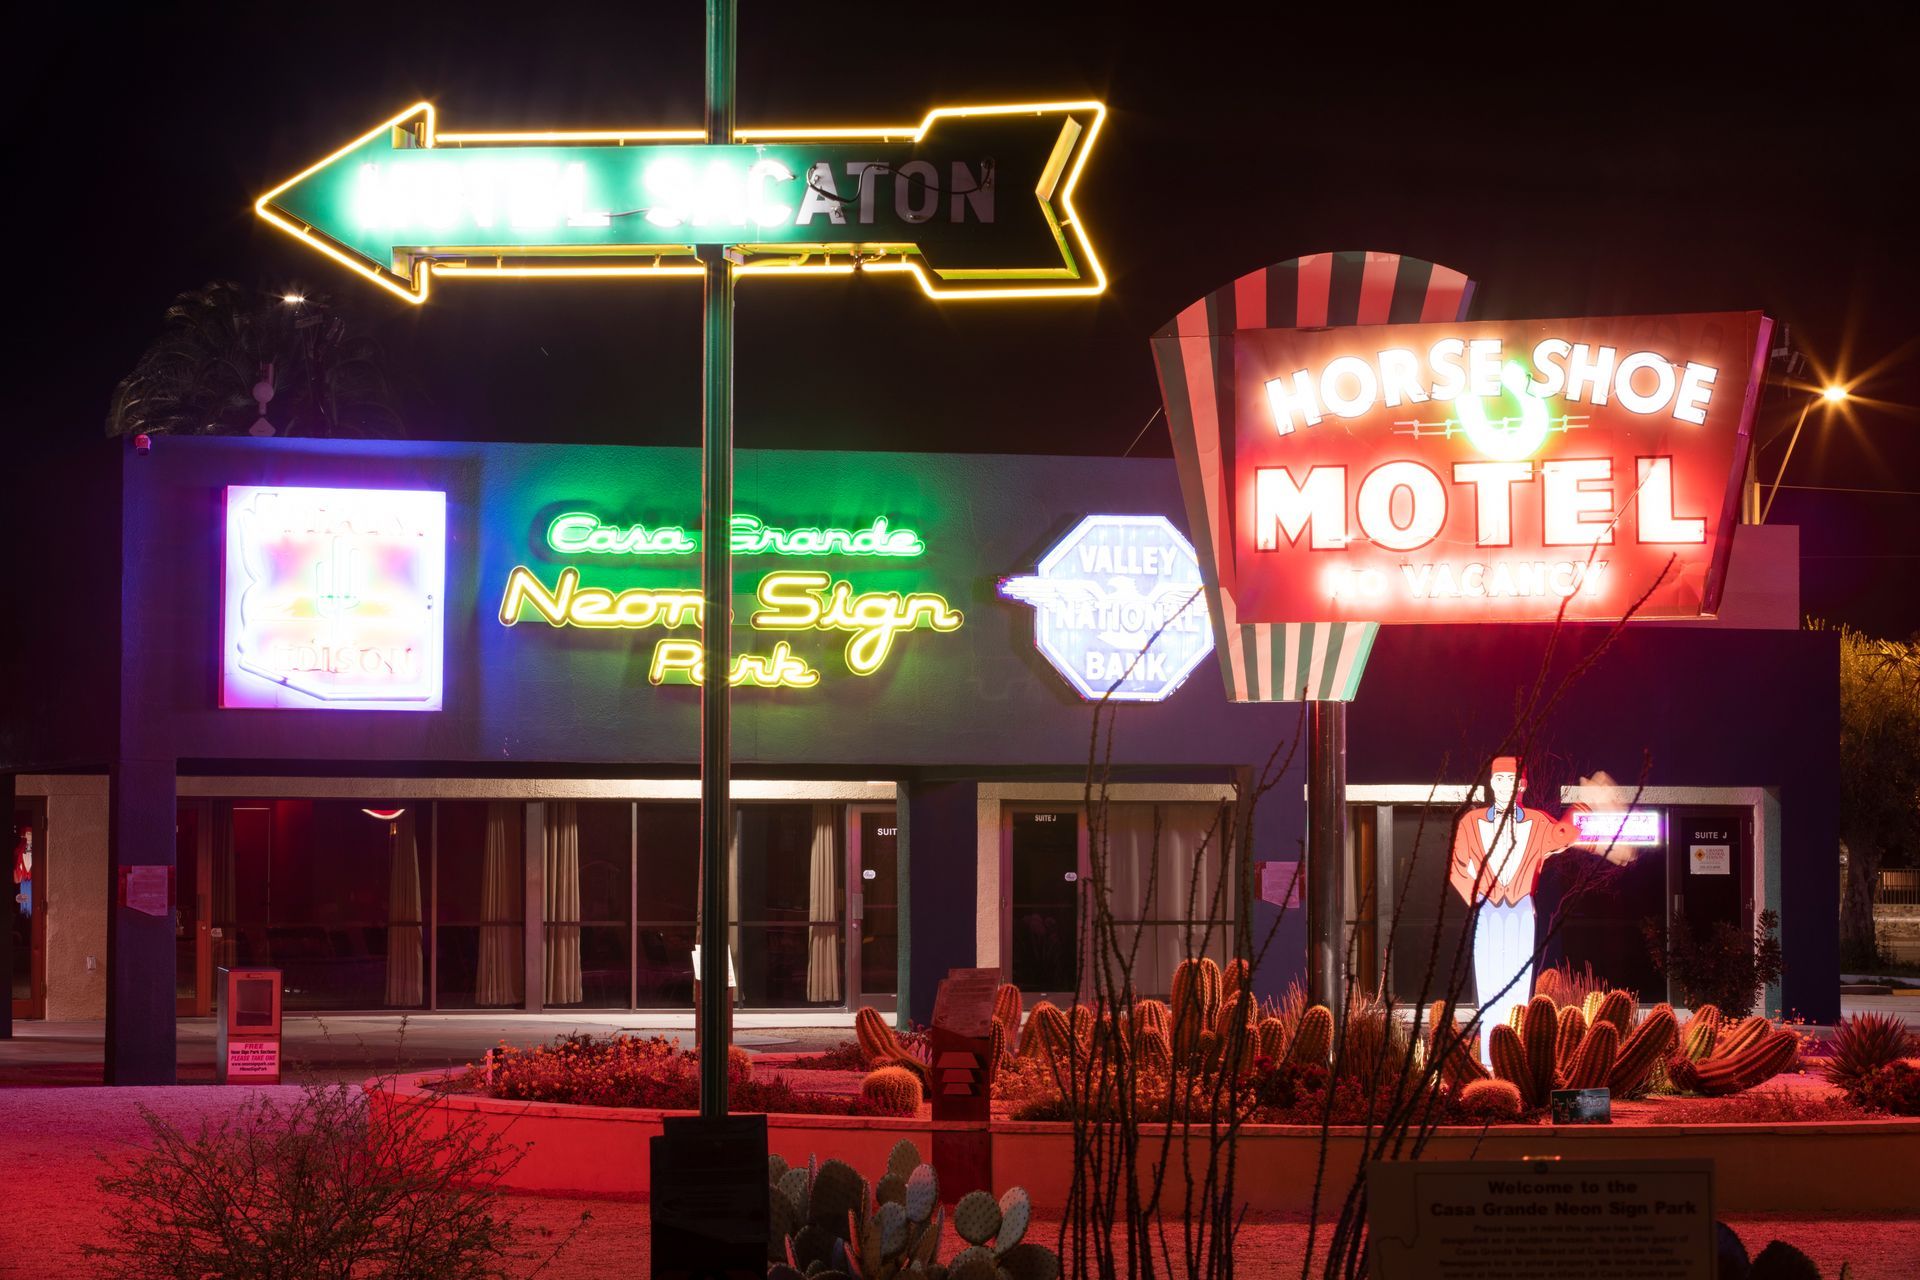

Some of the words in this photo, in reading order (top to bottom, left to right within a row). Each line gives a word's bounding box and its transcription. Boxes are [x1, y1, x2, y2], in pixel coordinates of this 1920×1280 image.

[1264, 337, 1503, 437] HORSE
[1532, 338, 1719, 427] SHOE
[1254, 454, 1708, 553] MOTEL
[547, 511, 697, 555] Casa
[1077, 544, 1178, 576] VALLEY
[1325, 566, 1389, 600] NO
[1400, 559, 1609, 599] VACANCY
[498, 564, 734, 630] Neon
[750, 569, 965, 676] Sign
[1054, 599, 1201, 633] NATIONAL
[1086, 651, 1168, 682] BANK
[1035, 814, 1051, 822] SUITE
[1695, 831, 1719, 839] SUITE
[1722, 831, 1728, 839] J
[1488, 1180, 1574, 1195] Welcome
[1580, 1180, 1599, 1194] to
[1606, 1179, 1638, 1194] the
[1430, 1202, 1476, 1217] Casa
[1482, 1202, 1548, 1216] Grande
[1555, 1202, 1603, 1216] Neon
[1608, 1200, 1648, 1218] Sign
[1655, 1200, 1697, 1215] Park
